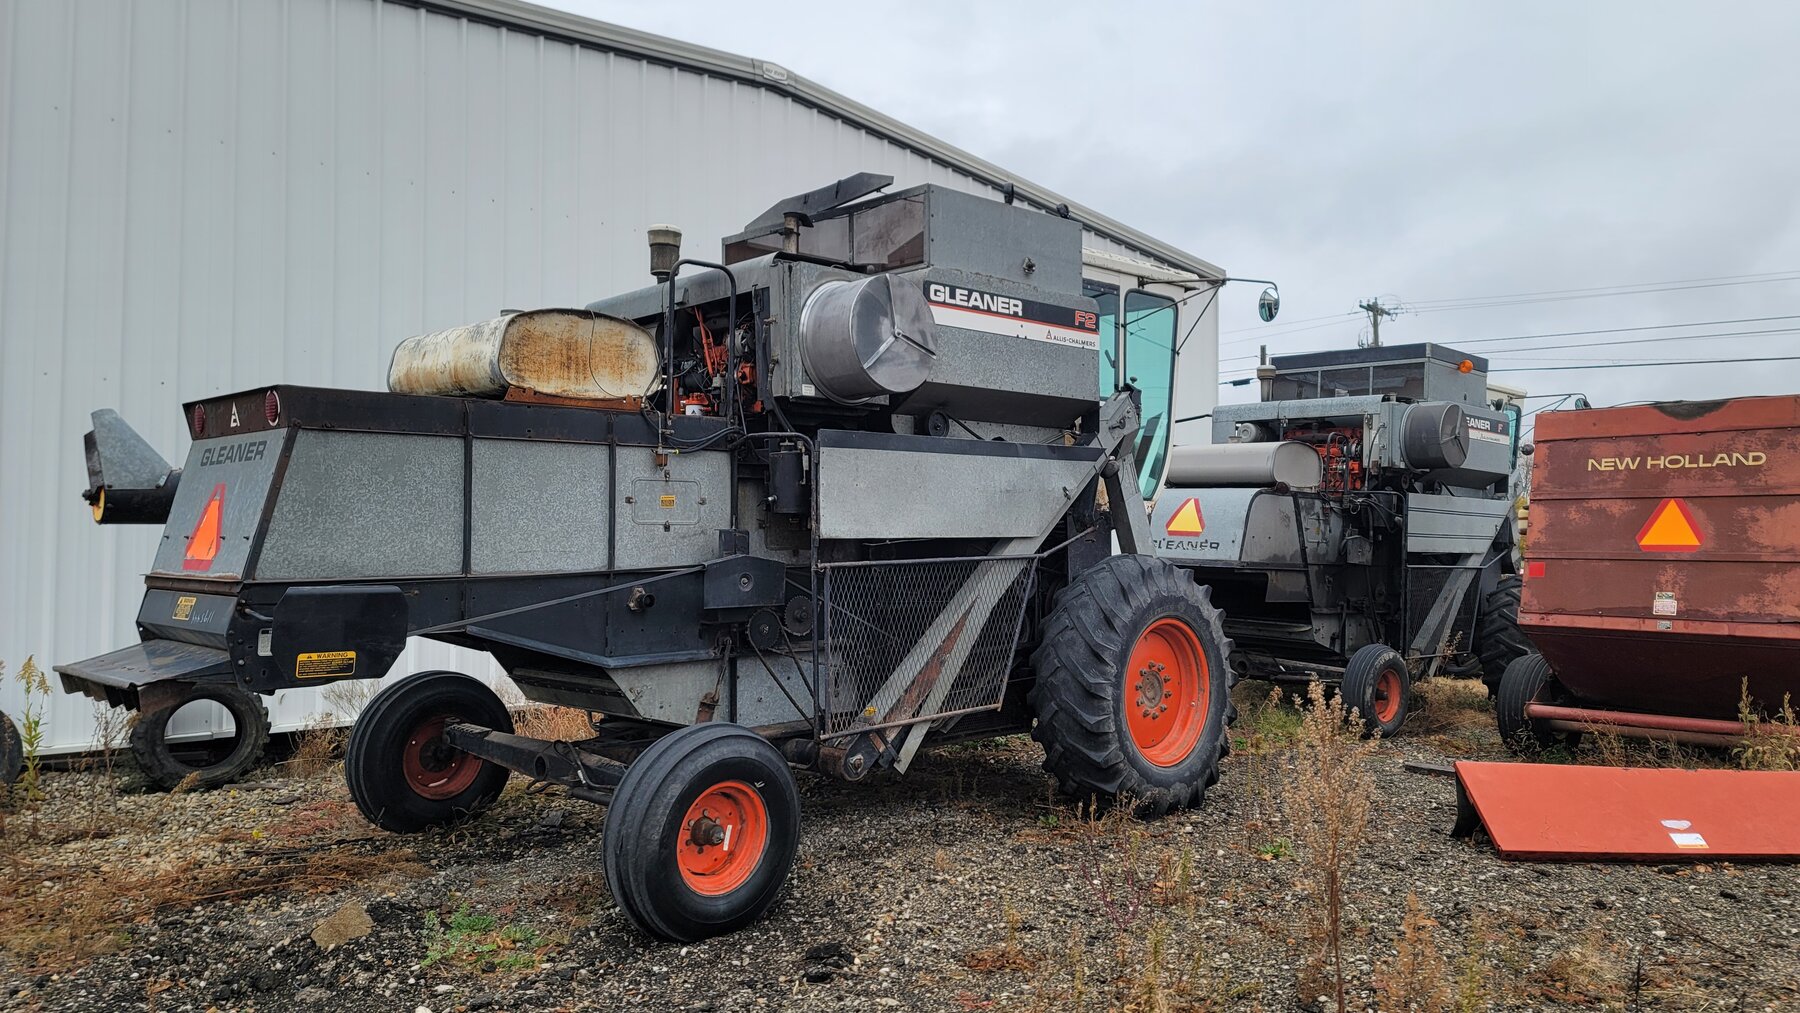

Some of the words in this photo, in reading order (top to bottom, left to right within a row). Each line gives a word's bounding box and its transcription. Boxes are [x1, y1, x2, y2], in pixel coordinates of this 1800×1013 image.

[929, 284, 1023, 316] GLEANER
[1074, 310, 1097, 329] F2
[1053, 335, 1096, 347] ALLIS-CHALMERS
[1466, 416, 1491, 431] EANER
[201, 440, 267, 467] GLEANER
[1587, 457, 1641, 471] NEW
[1647, 452, 1767, 470] HOLLAND
